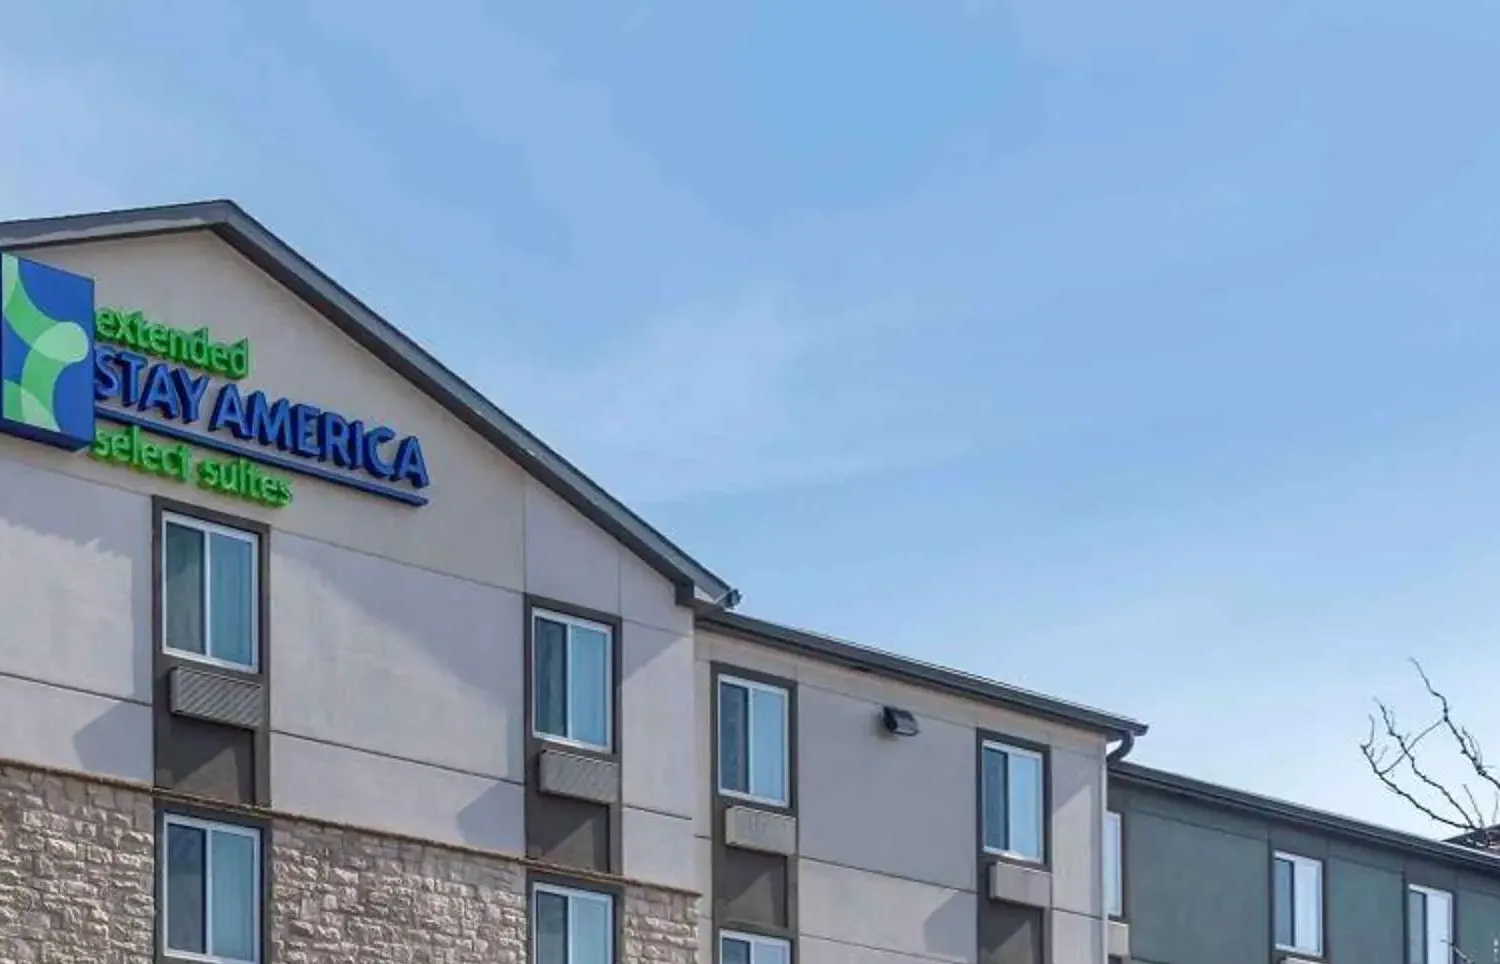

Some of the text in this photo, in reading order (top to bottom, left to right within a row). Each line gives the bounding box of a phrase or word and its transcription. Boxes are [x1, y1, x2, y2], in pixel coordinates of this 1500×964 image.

[95, 308, 249, 379] extended
[94, 346, 429, 488] STAY AMERICA
[93, 425, 293, 507] select suites
